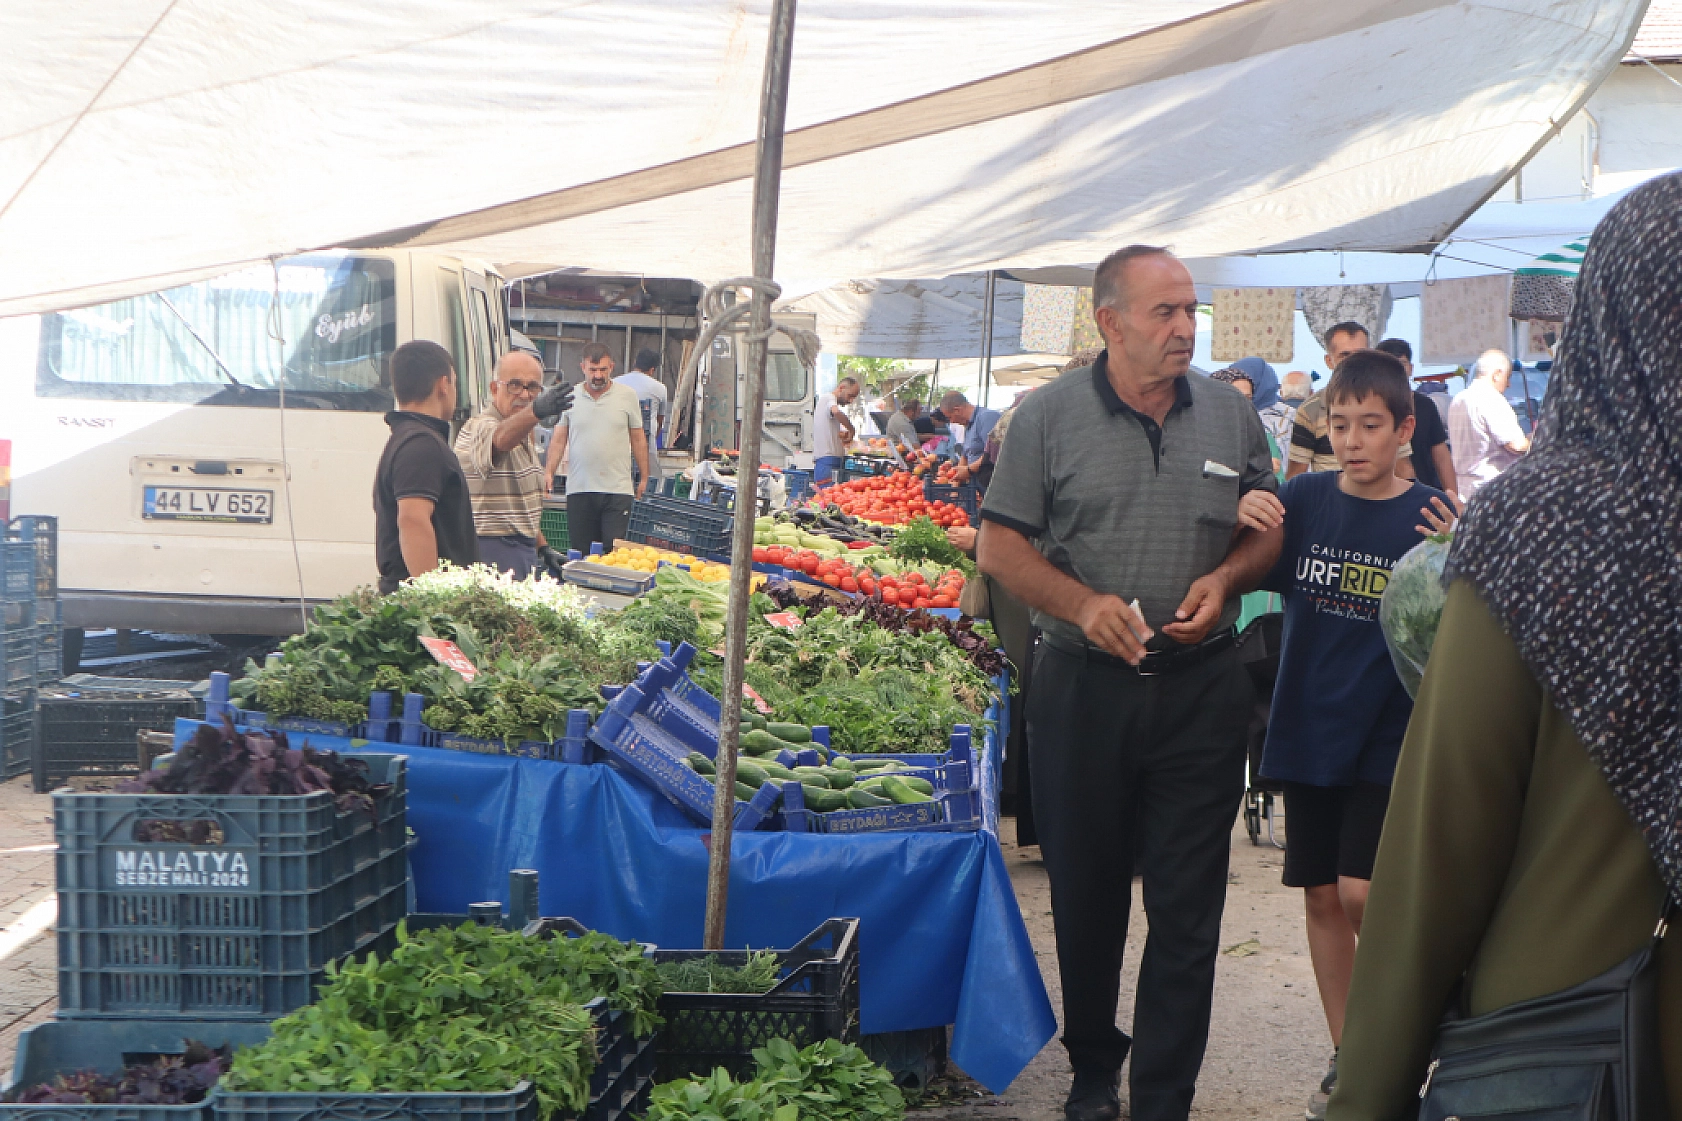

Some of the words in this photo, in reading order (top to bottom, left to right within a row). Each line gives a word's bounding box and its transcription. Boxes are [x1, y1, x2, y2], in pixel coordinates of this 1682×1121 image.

[156, 491, 181, 511] 44
[190, 492, 219, 512] LV
[229, 494, 267, 514] 652
[1296, 557, 1341, 586] URF
[1344, 566, 1389, 594] RID
[830, 813, 887, 832] BEYDAĞI
[916, 808, 929, 823] 3
[115, 850, 249, 872] MALATYA
[115, 872, 169, 886] SEBZE
[211, 872, 249, 887] 2024
